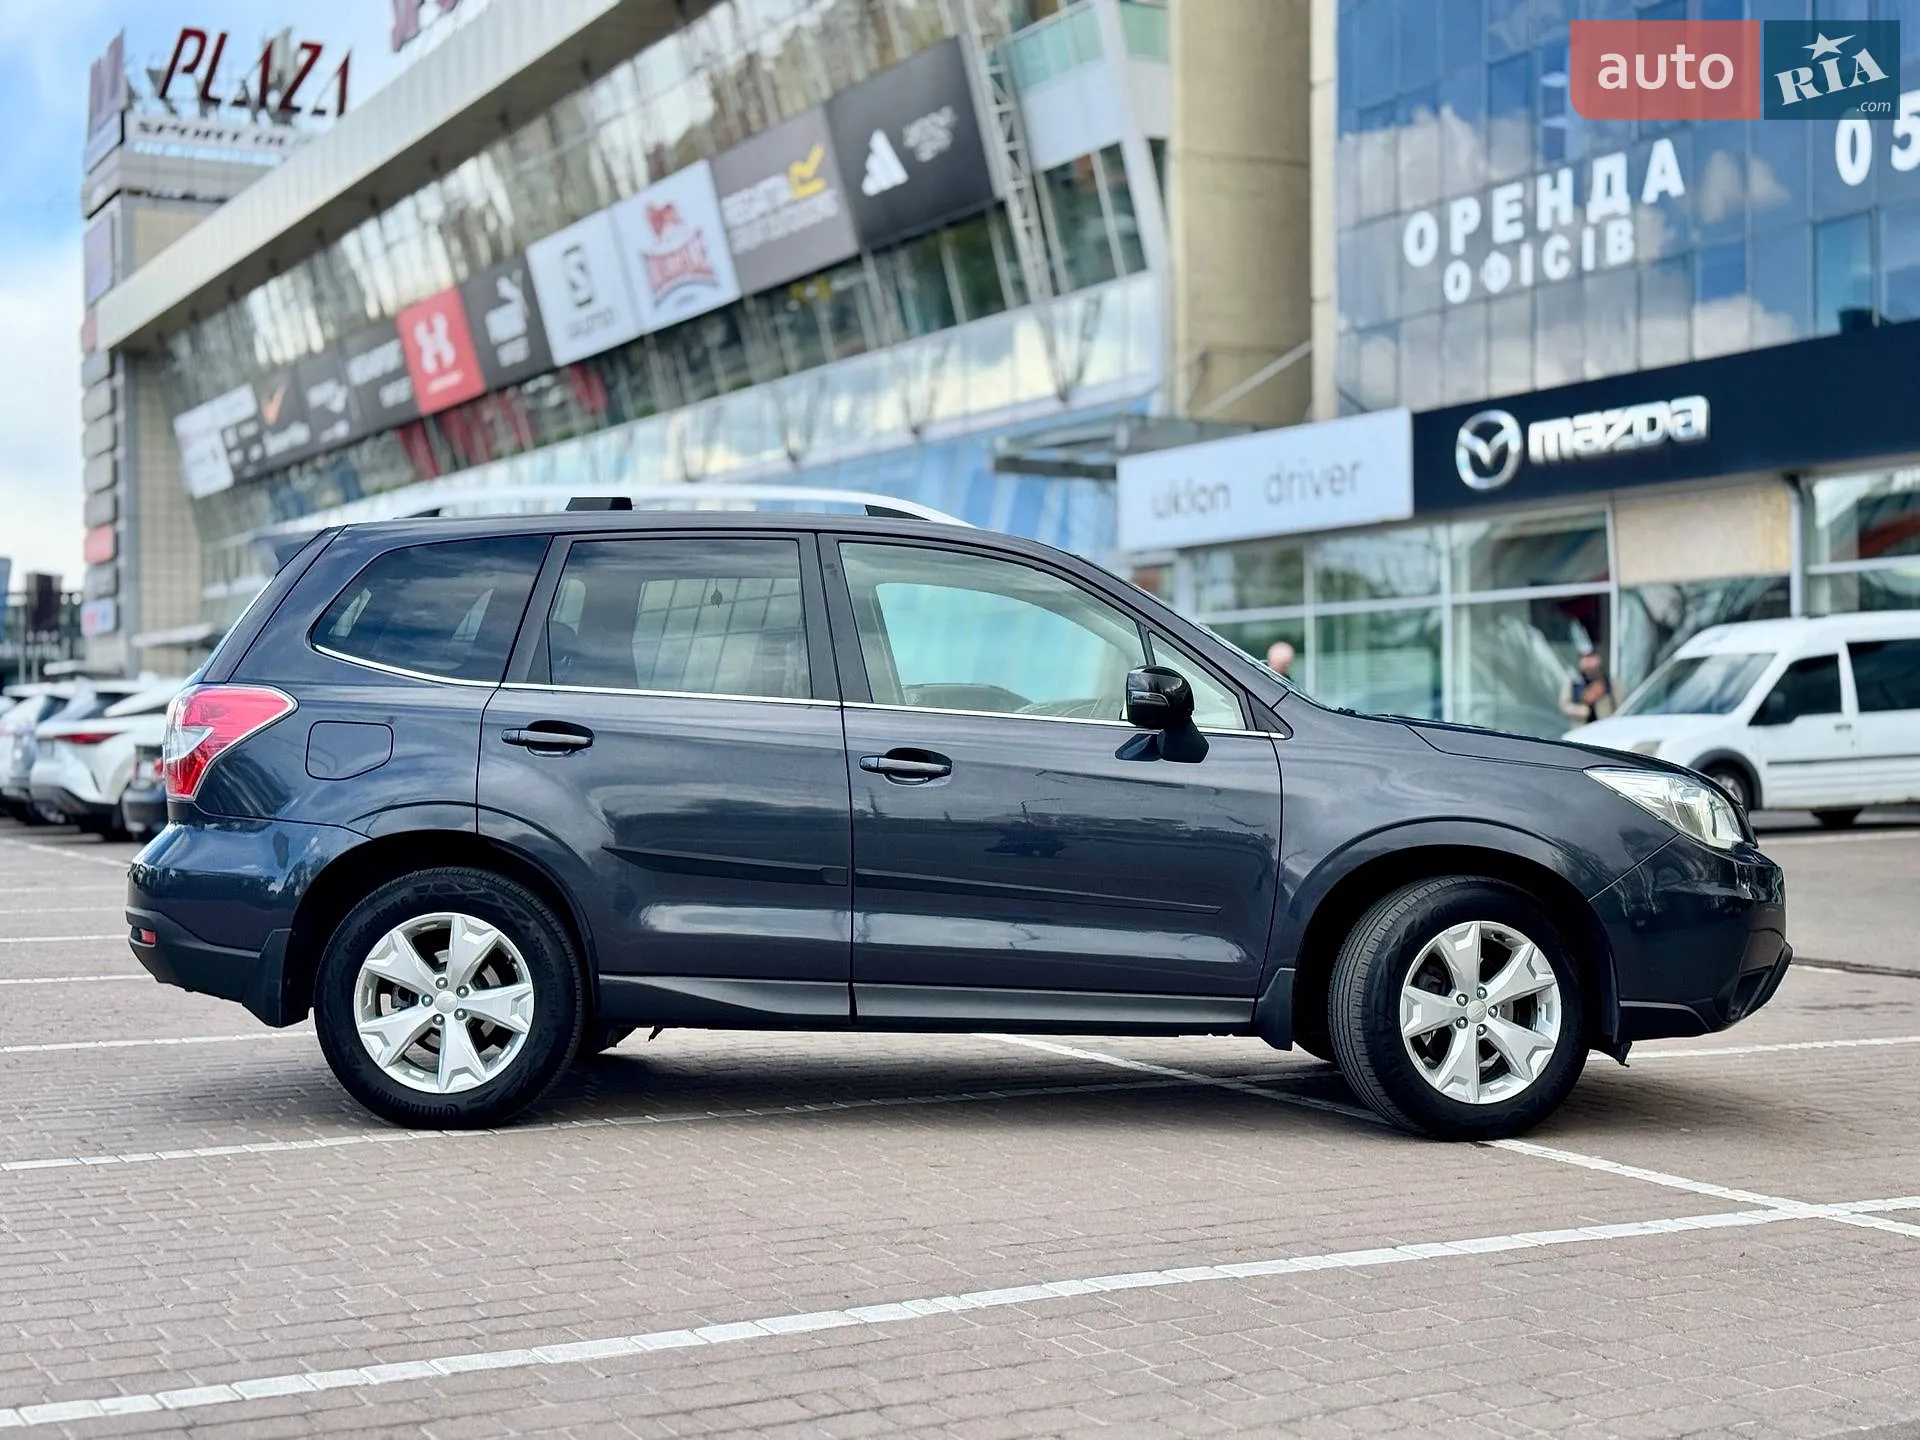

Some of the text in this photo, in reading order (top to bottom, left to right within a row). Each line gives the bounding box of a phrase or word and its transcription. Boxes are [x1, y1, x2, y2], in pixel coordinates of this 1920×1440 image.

[159, 27, 352, 118] PLAZA
[1403, 138, 1685, 267] ОРЕНДА
[1443, 217, 1634, 304] ОФІСІВ
[1528, 395, 1711, 465] mazda
[1151, 458, 1362, 519] uklon driver
